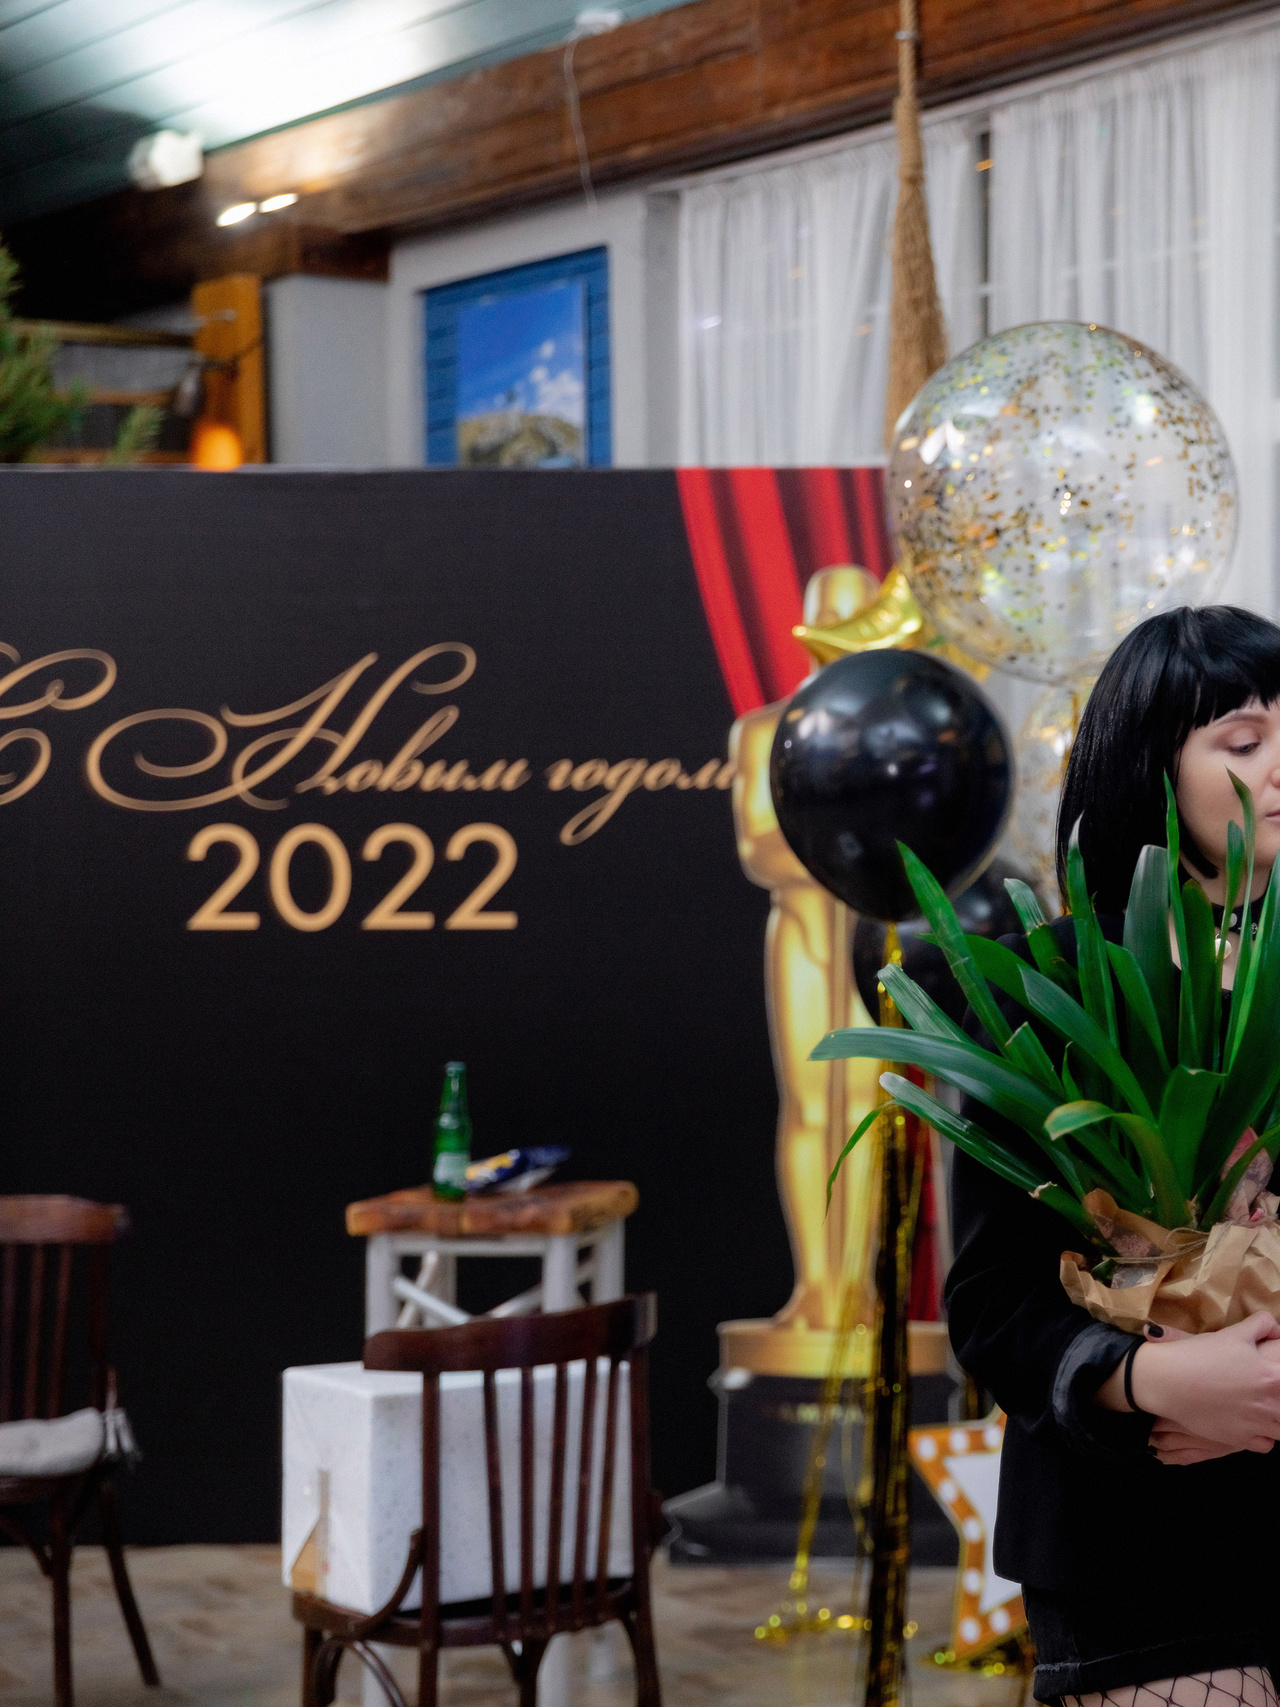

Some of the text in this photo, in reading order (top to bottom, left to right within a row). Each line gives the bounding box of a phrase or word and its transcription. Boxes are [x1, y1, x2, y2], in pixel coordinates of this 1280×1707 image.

[86, 641, 532, 812] Новым
[545, 757, 739, 846] годом
[186, 822, 519, 932] 2022
